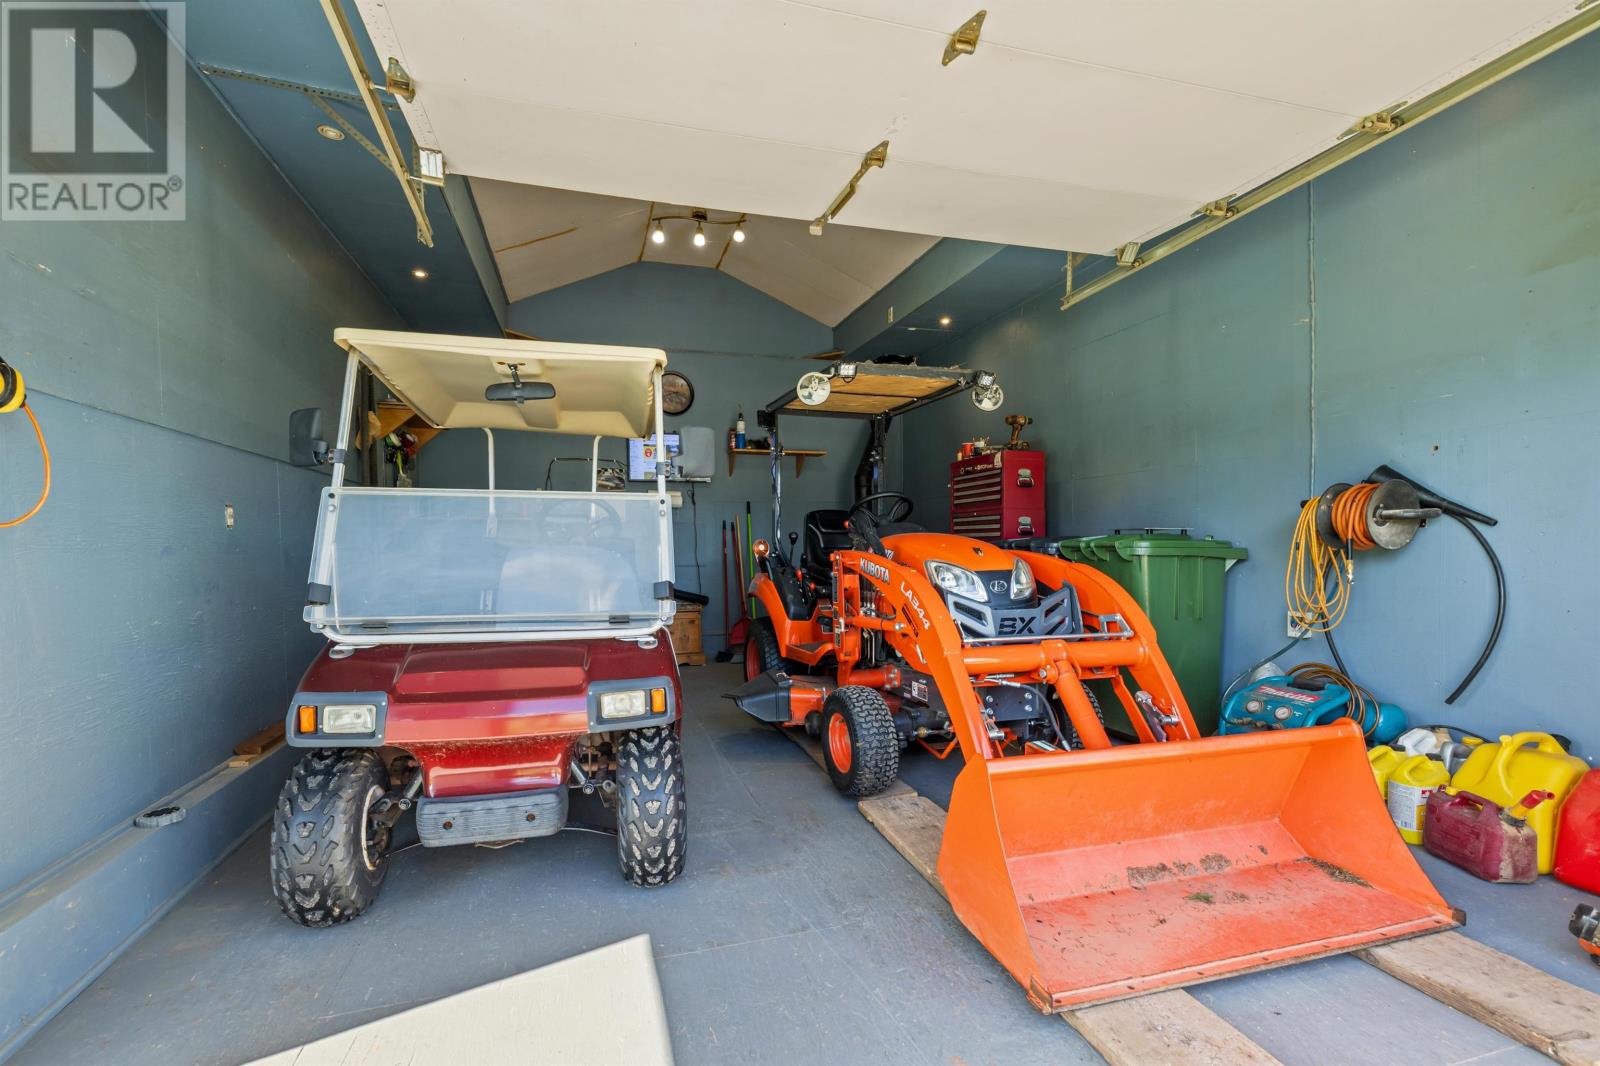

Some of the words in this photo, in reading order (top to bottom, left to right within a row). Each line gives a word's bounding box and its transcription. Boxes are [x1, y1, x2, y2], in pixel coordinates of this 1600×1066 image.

[860, 557, 890, 584] KUBOTA
[900, 581, 930, 630] LA344
[998, 616, 1037, 635] BX
